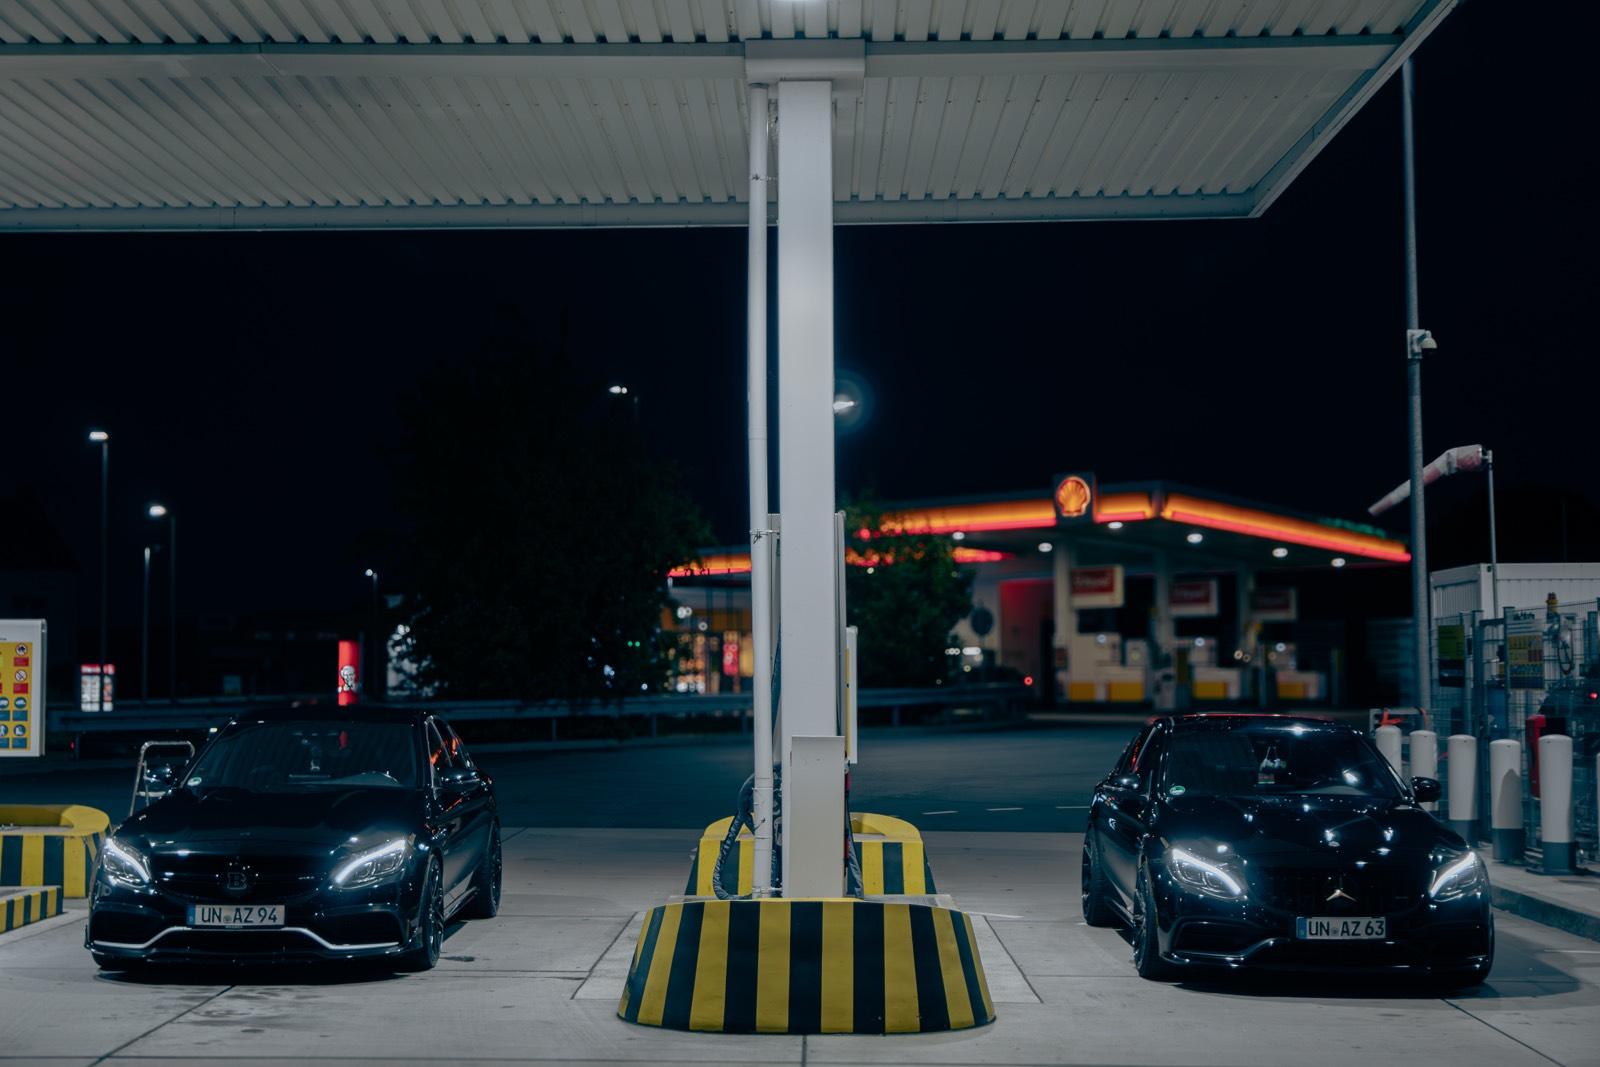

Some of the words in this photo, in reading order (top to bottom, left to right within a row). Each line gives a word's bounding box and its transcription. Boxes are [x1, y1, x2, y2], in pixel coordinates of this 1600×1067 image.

[201, 907, 222, 923] UN
[233, 907, 254, 923] AZ
[258, 907, 277, 923] 94
[1308, 920, 1330, 936] UN
[1340, 920, 1361, 936] AZ
[1365, 920, 1385, 936] 63
